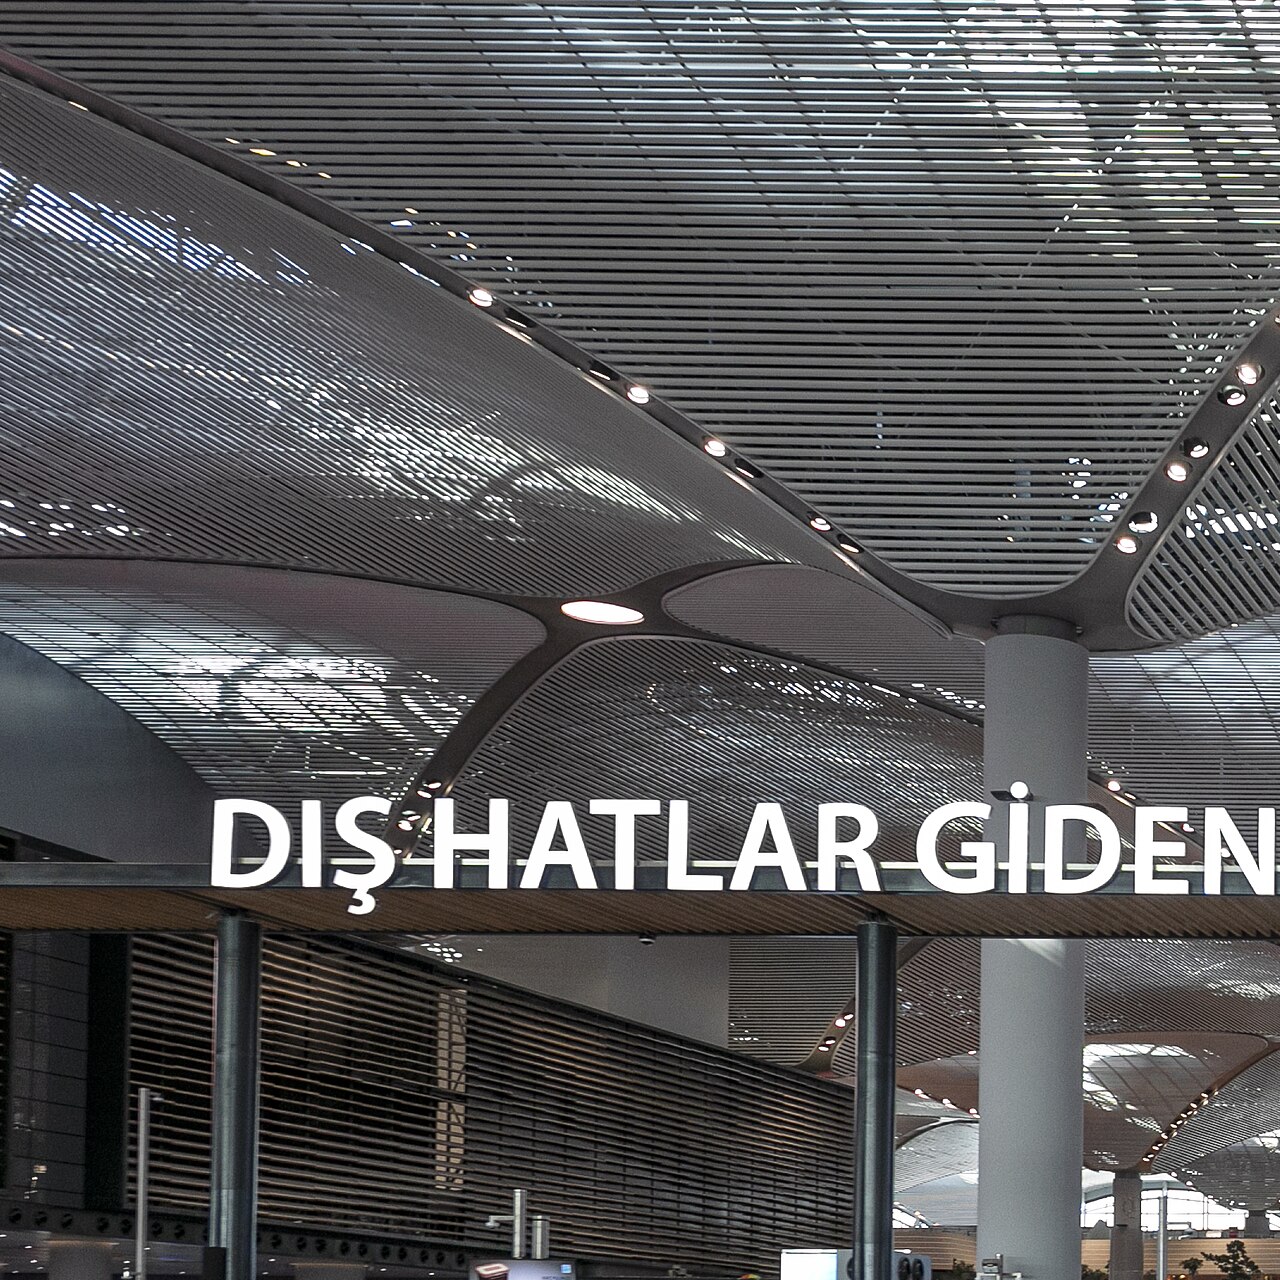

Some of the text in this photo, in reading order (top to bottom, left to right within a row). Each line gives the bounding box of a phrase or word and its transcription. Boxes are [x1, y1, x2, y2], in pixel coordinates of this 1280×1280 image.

[209, 796, 396, 914] DIŞ
[432, 797, 882, 892] HATLAR
[915, 781, 1276, 895] GİDEN
